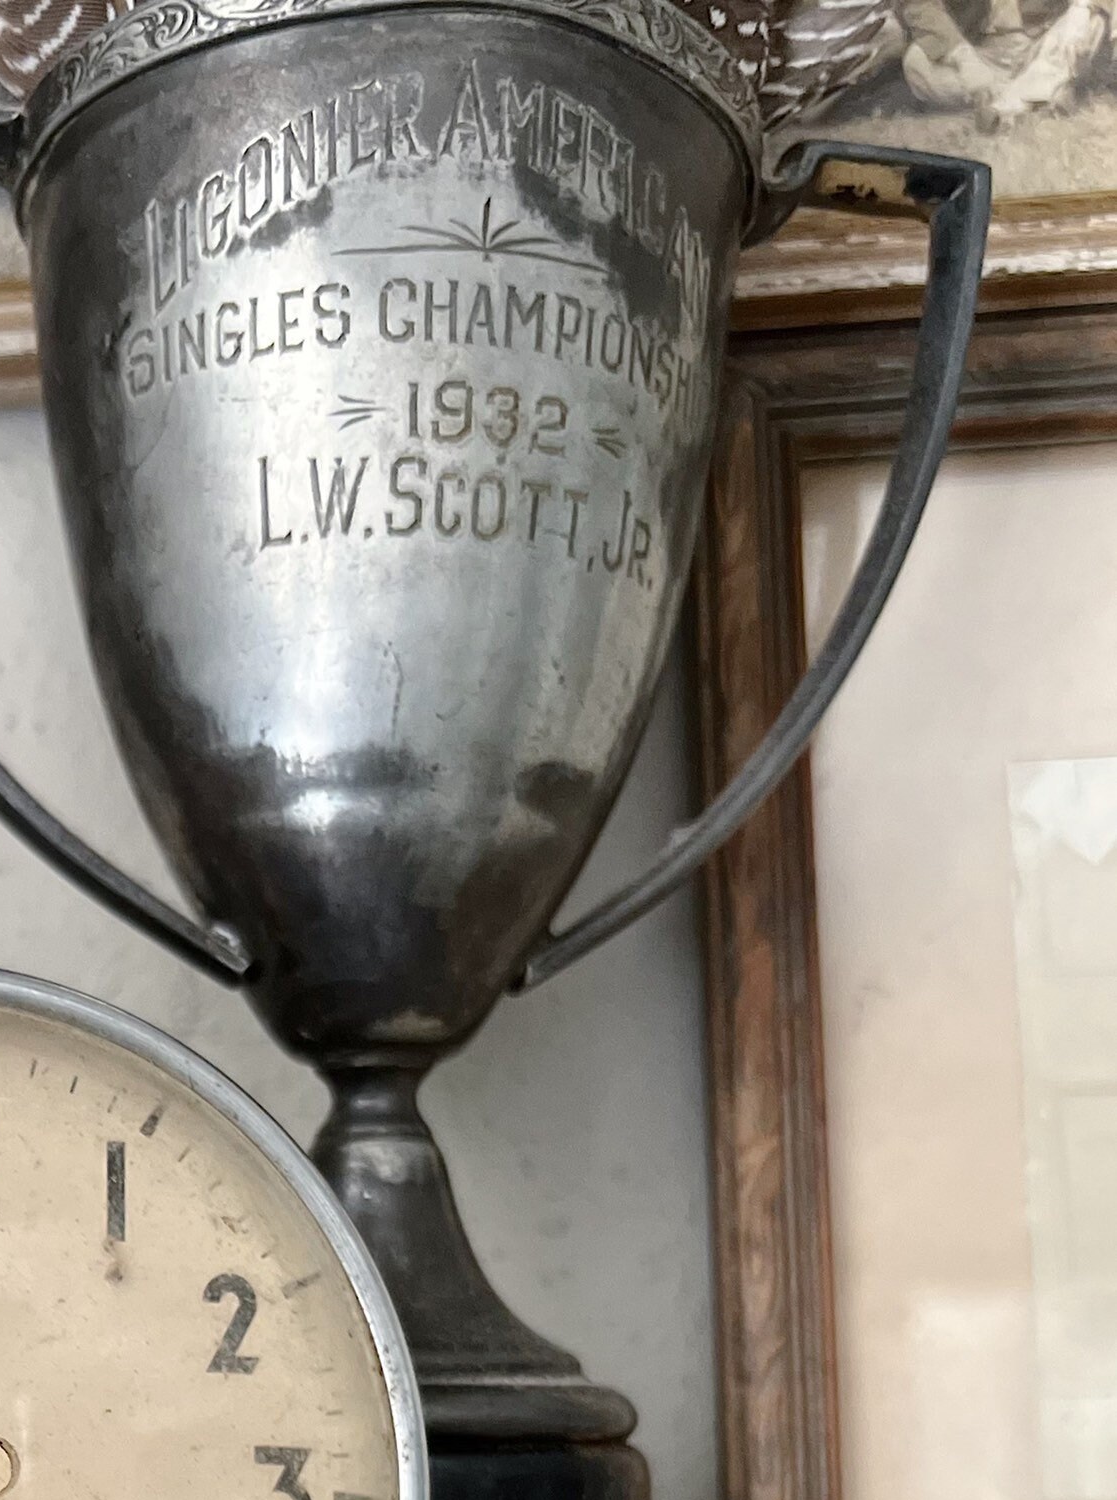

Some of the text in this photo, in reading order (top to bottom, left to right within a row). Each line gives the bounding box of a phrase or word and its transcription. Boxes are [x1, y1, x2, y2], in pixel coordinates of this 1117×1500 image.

[145, 58, 710, 345] LIGONIER AMERICAN
[125, 282, 351, 397] SINGLES
[408, 380, 569, 456] 1932
[105, 1140, 127, 1242] 1
[202, 1273, 260, 1374] 2
